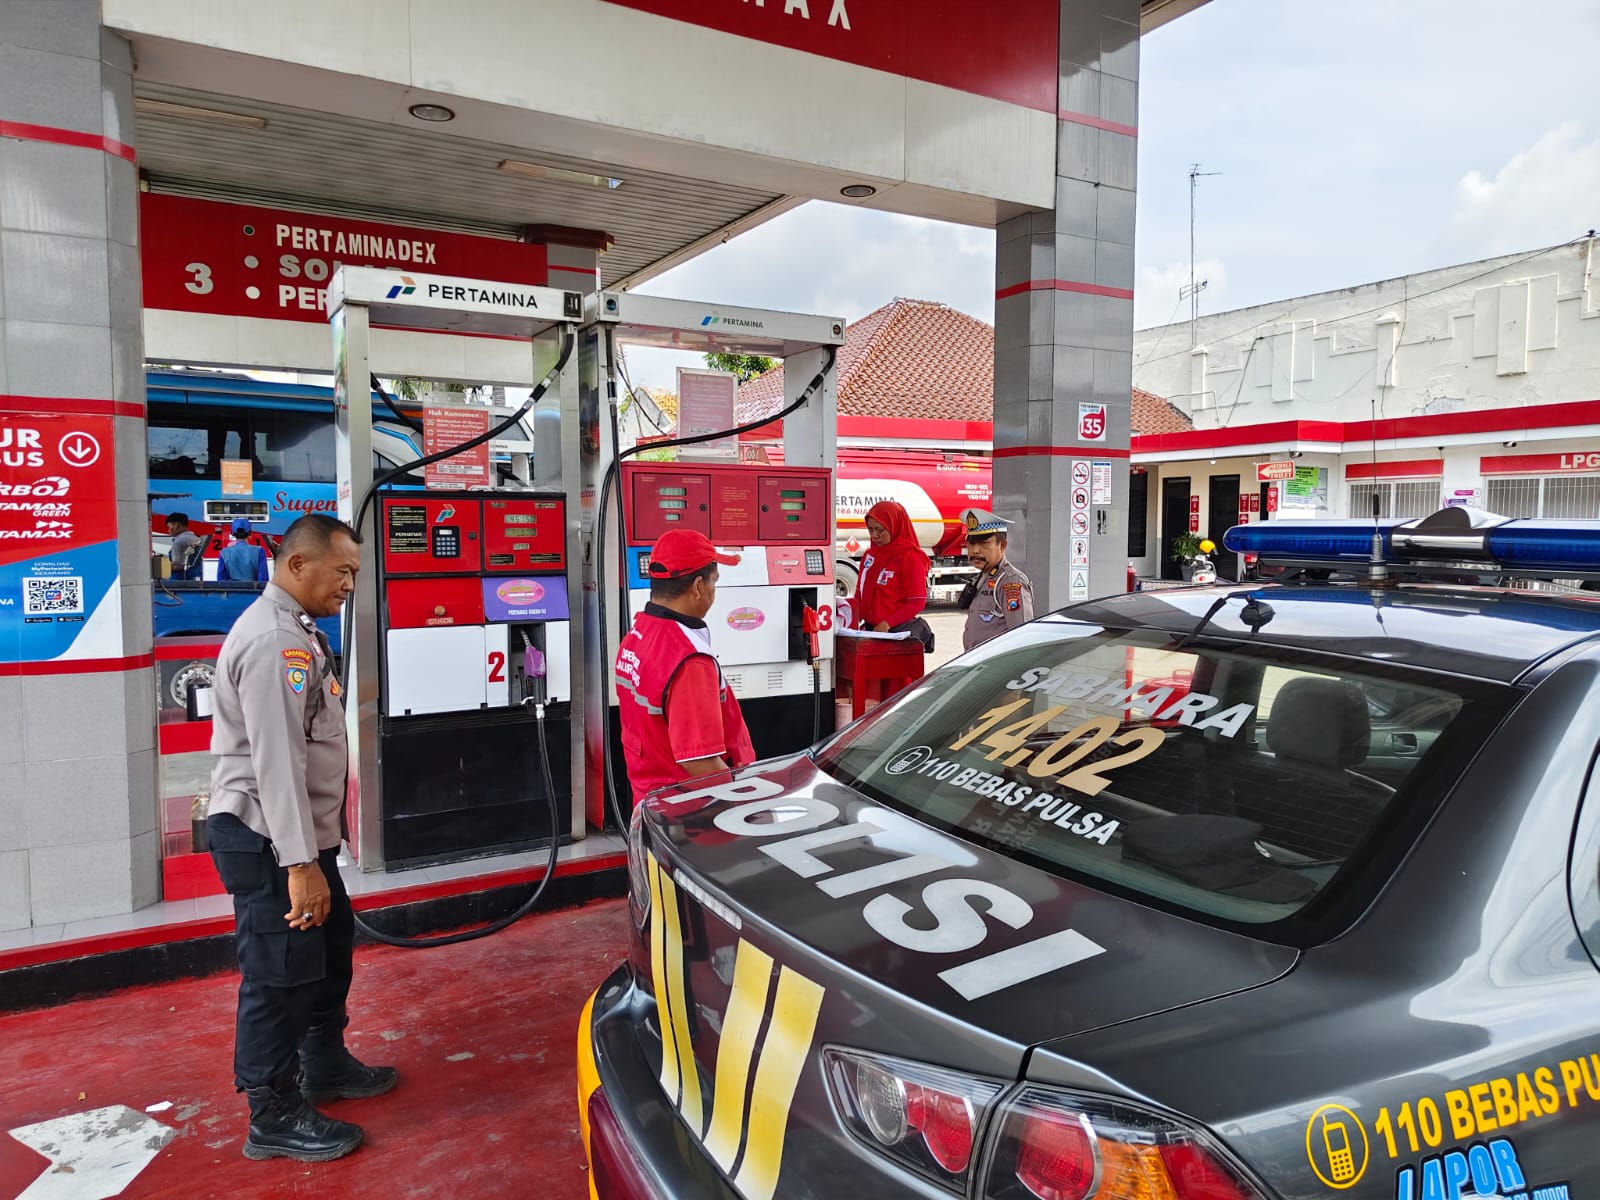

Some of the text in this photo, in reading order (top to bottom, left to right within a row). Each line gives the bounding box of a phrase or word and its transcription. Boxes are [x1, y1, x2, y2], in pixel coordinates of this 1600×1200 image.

[276, 223, 437, 265] PERTAMINADEX
[184, 262, 214, 295] 3
[279, 284, 328, 311] PER
[428, 284, 538, 309] PERTAMINA
[722, 317, 763, 329] PERTAMINA
[0, 428, 43, 448] UR
[1080, 418, 1102, 434] 135
[0, 451, 44, 467] US
[1560, 453, 1600, 469] LPG
[0, 484, 54, 496] RBO
[273, 490, 338, 517] Sugen
[0, 502, 72, 511] TAMAX
[0, 530, 73, 539] TAMAX
[213, 539, 222, 550] 2
[818, 604, 832, 631] 3
[488, 651, 505, 683] 2
[1006, 667, 1255, 738] SABHARA
[949, 698, 1166, 796] 14.02
[917, 757, 1121, 846] 110 BEBAS PULSA
[662, 777, 1107, 1001] POLISI
[1375, 1053, 1600, 1158] 110 BEBAS PU
